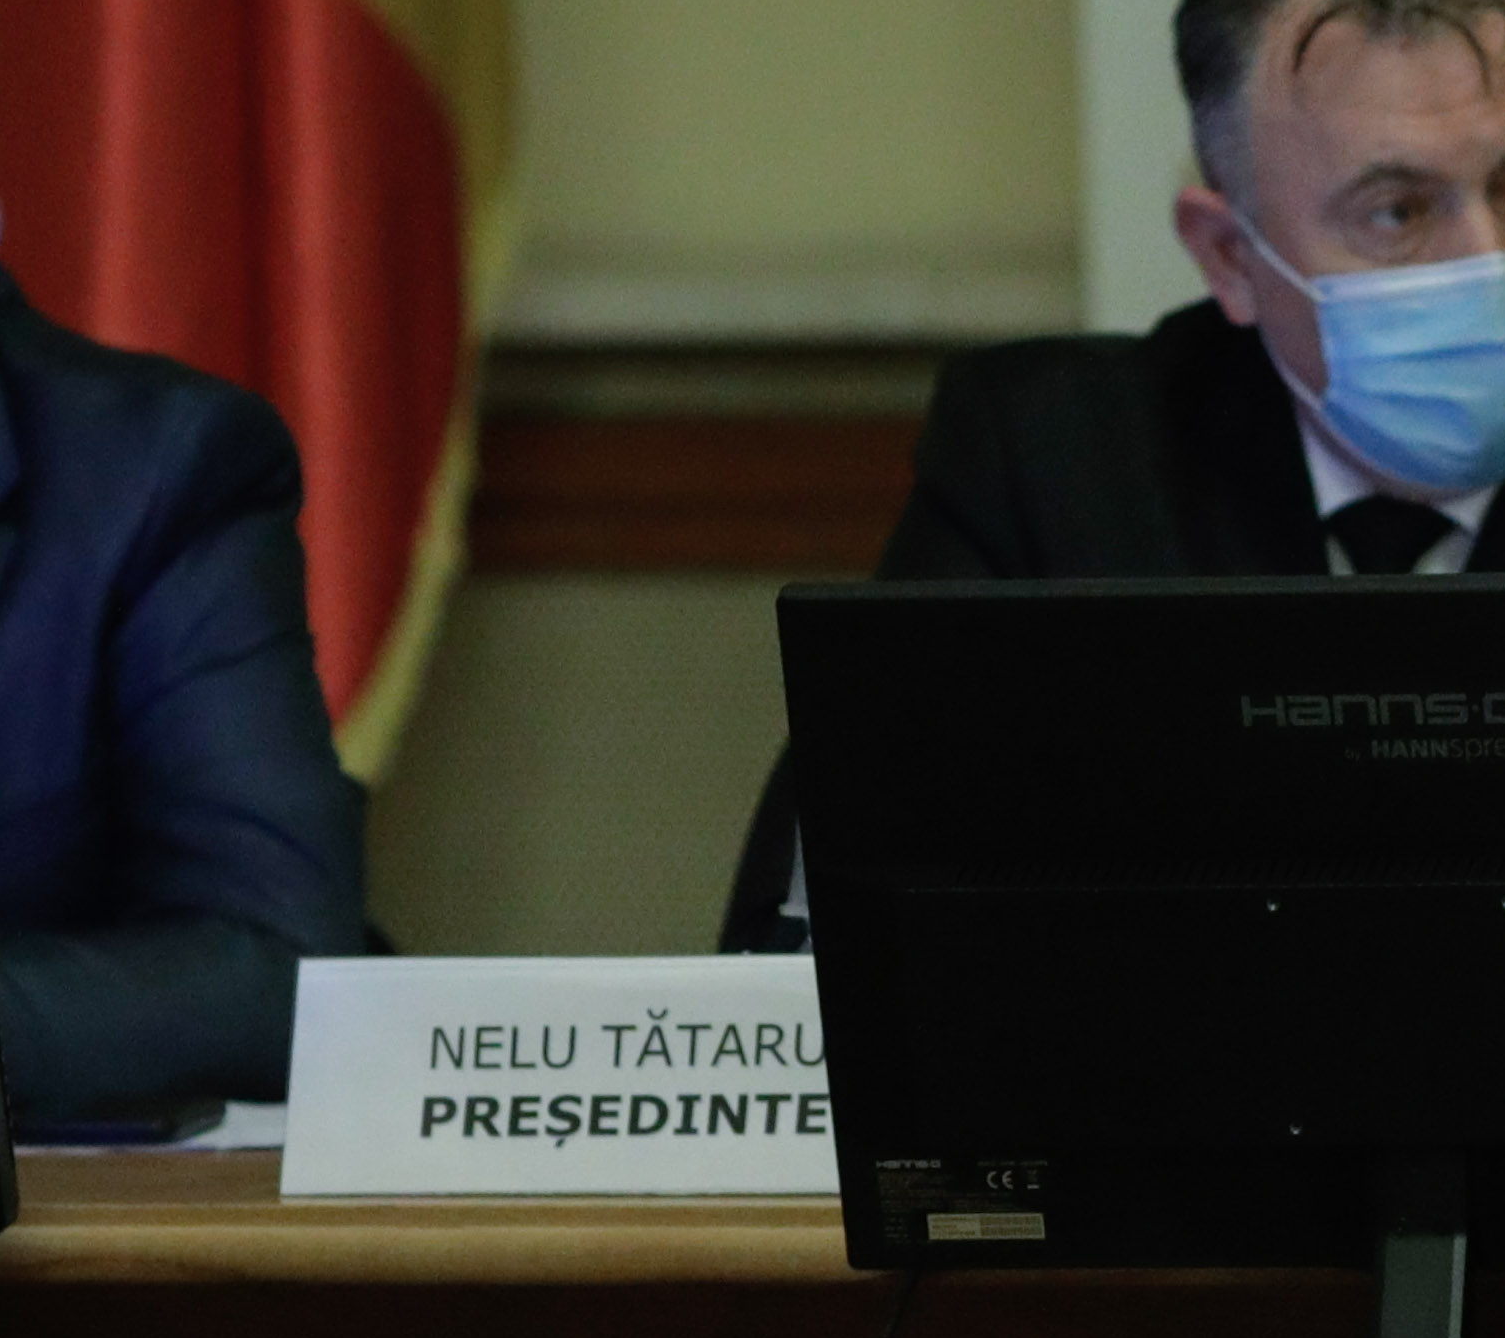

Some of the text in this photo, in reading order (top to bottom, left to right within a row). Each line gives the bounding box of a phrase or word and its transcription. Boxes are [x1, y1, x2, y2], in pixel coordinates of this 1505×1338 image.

[430, 1008, 826, 1069] NELU TĂTARU
[420, 1093, 831, 1148] PREȘEDINTE
